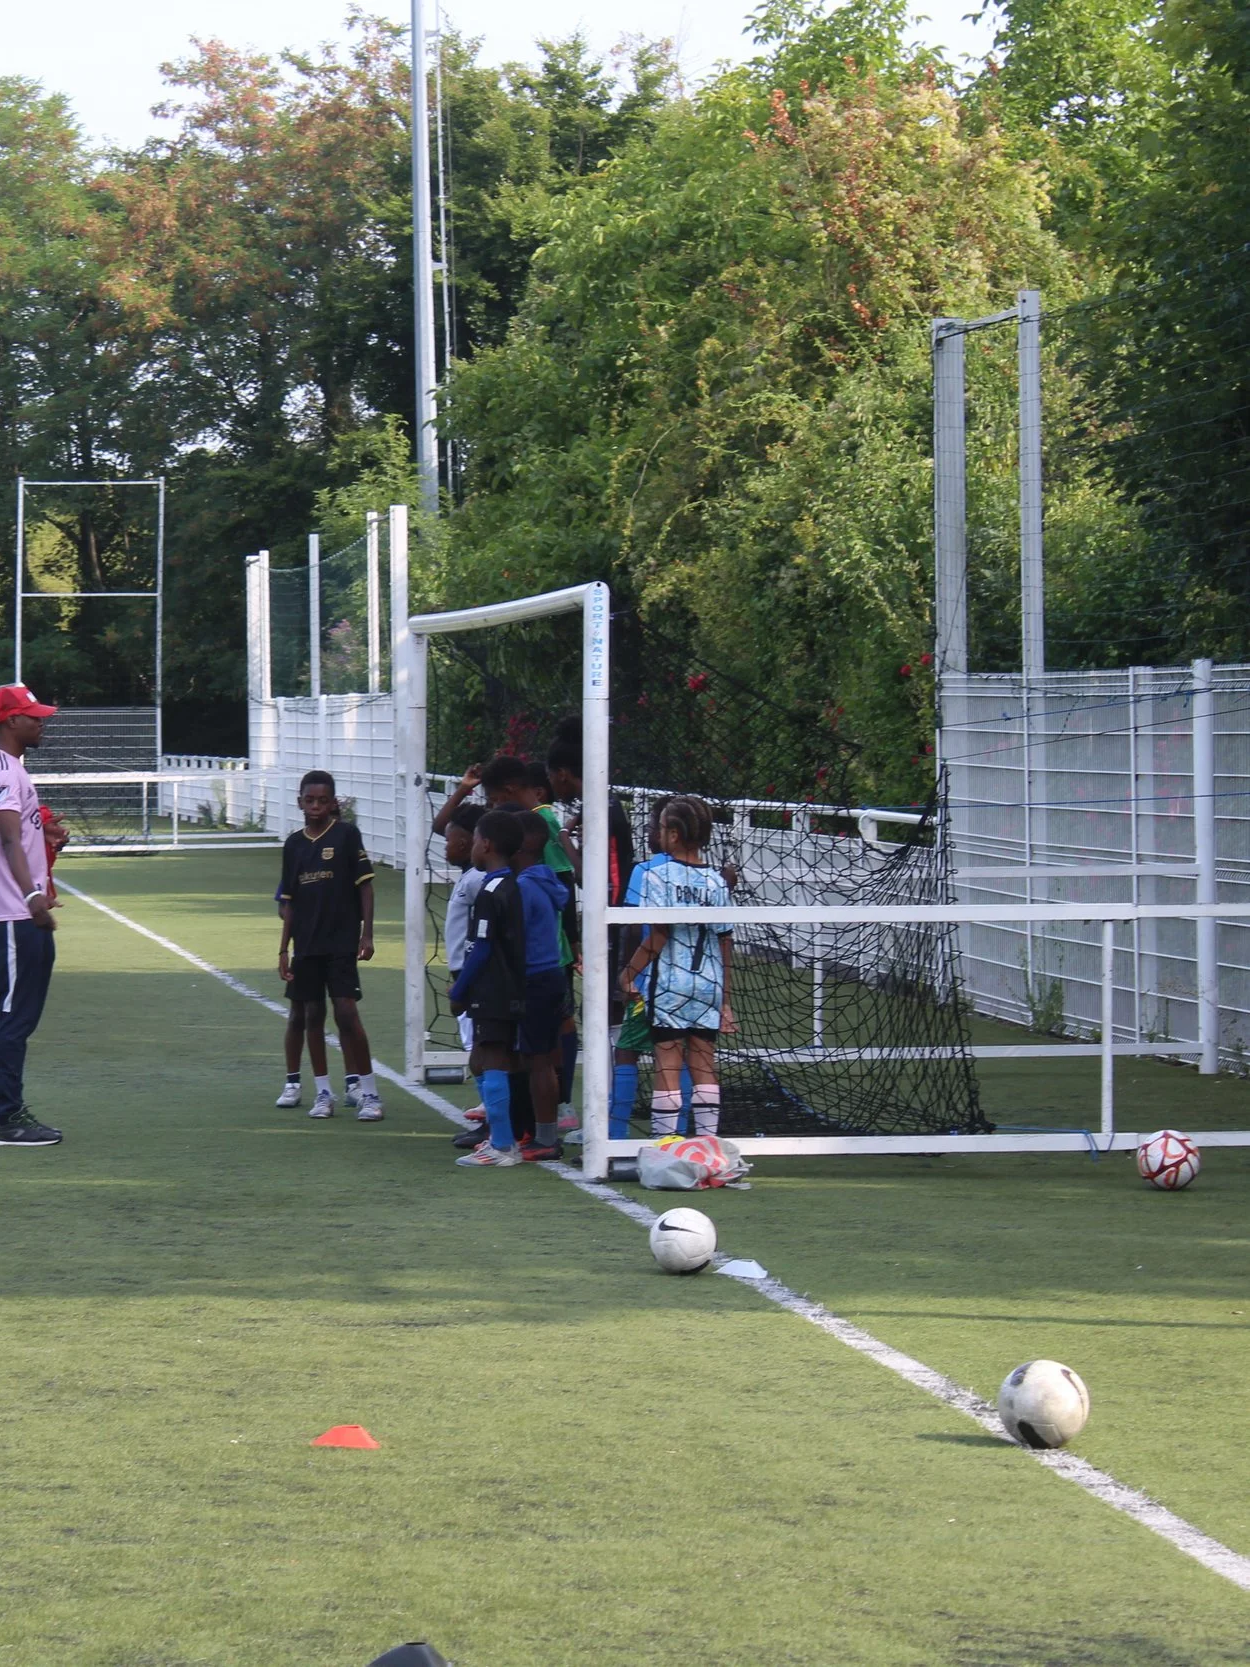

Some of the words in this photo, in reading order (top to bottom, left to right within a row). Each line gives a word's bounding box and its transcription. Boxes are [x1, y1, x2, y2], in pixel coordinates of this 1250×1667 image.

[592, 588, 603, 628] SPORT
[591, 637, 603, 686] NATURE
[298, 870, 334, 882] akuten
